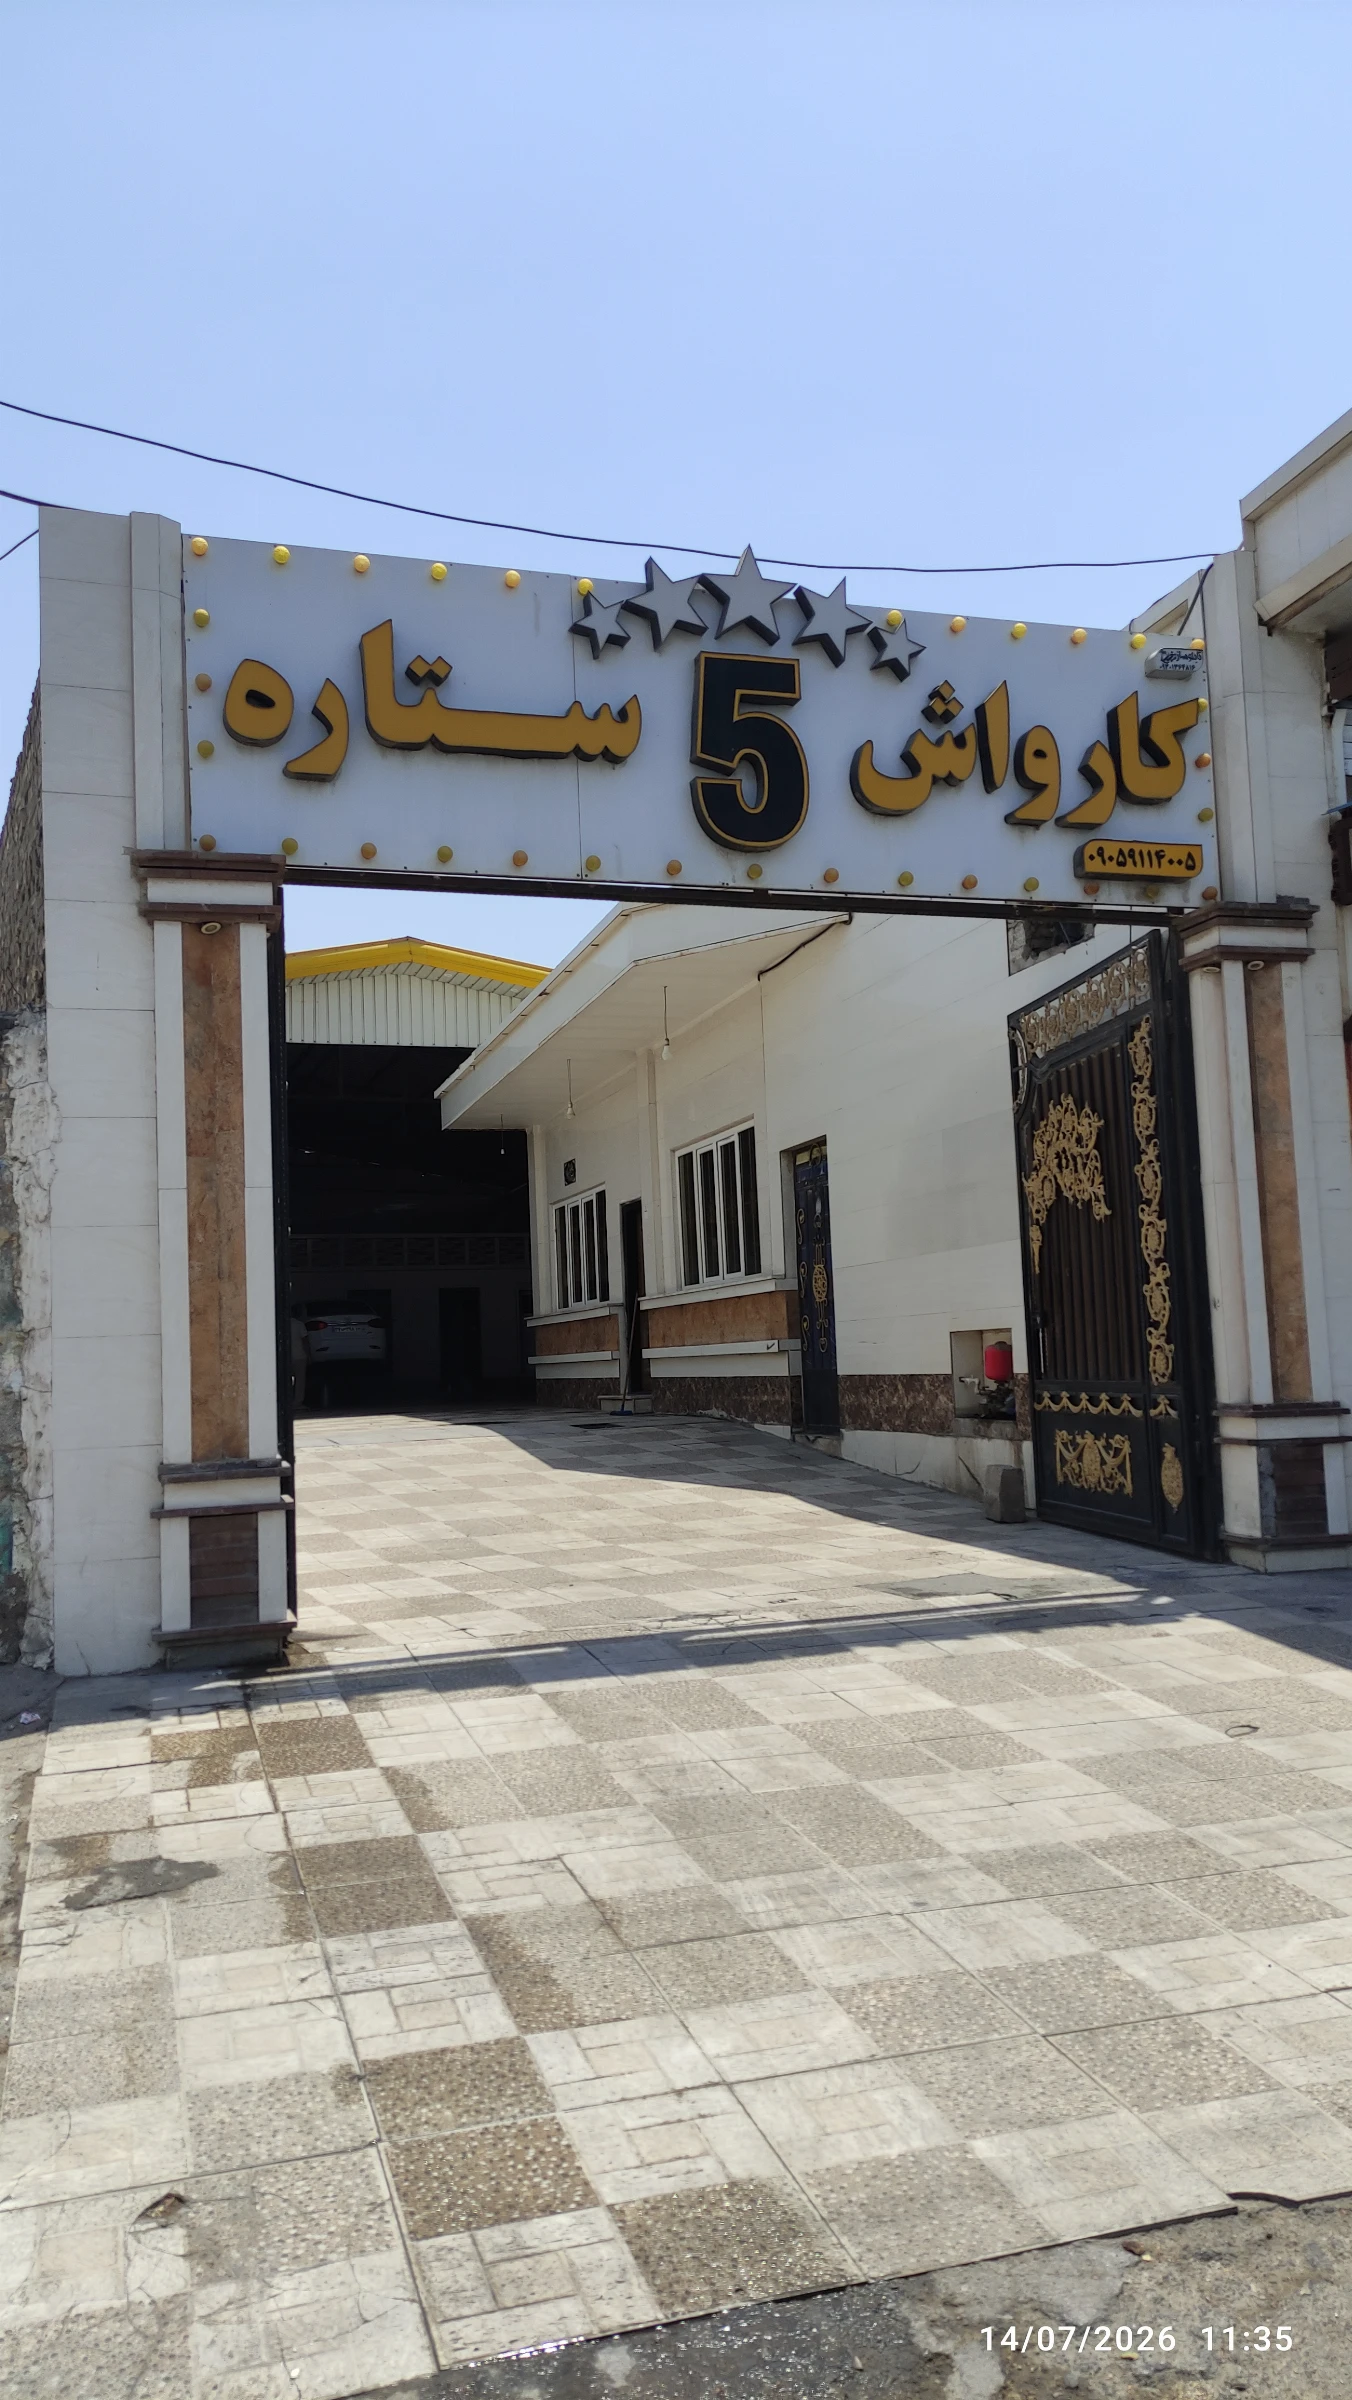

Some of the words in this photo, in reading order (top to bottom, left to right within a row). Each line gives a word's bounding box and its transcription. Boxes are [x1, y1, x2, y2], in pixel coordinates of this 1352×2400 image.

[223, 619, 642, 782] ستاره
[690, 651, 810, 852] 5
[850, 679, 1200, 829] کارواش
[1088, 846, 1197, 871] ۰۹۰۵۹۱۱۴۰۰۵
